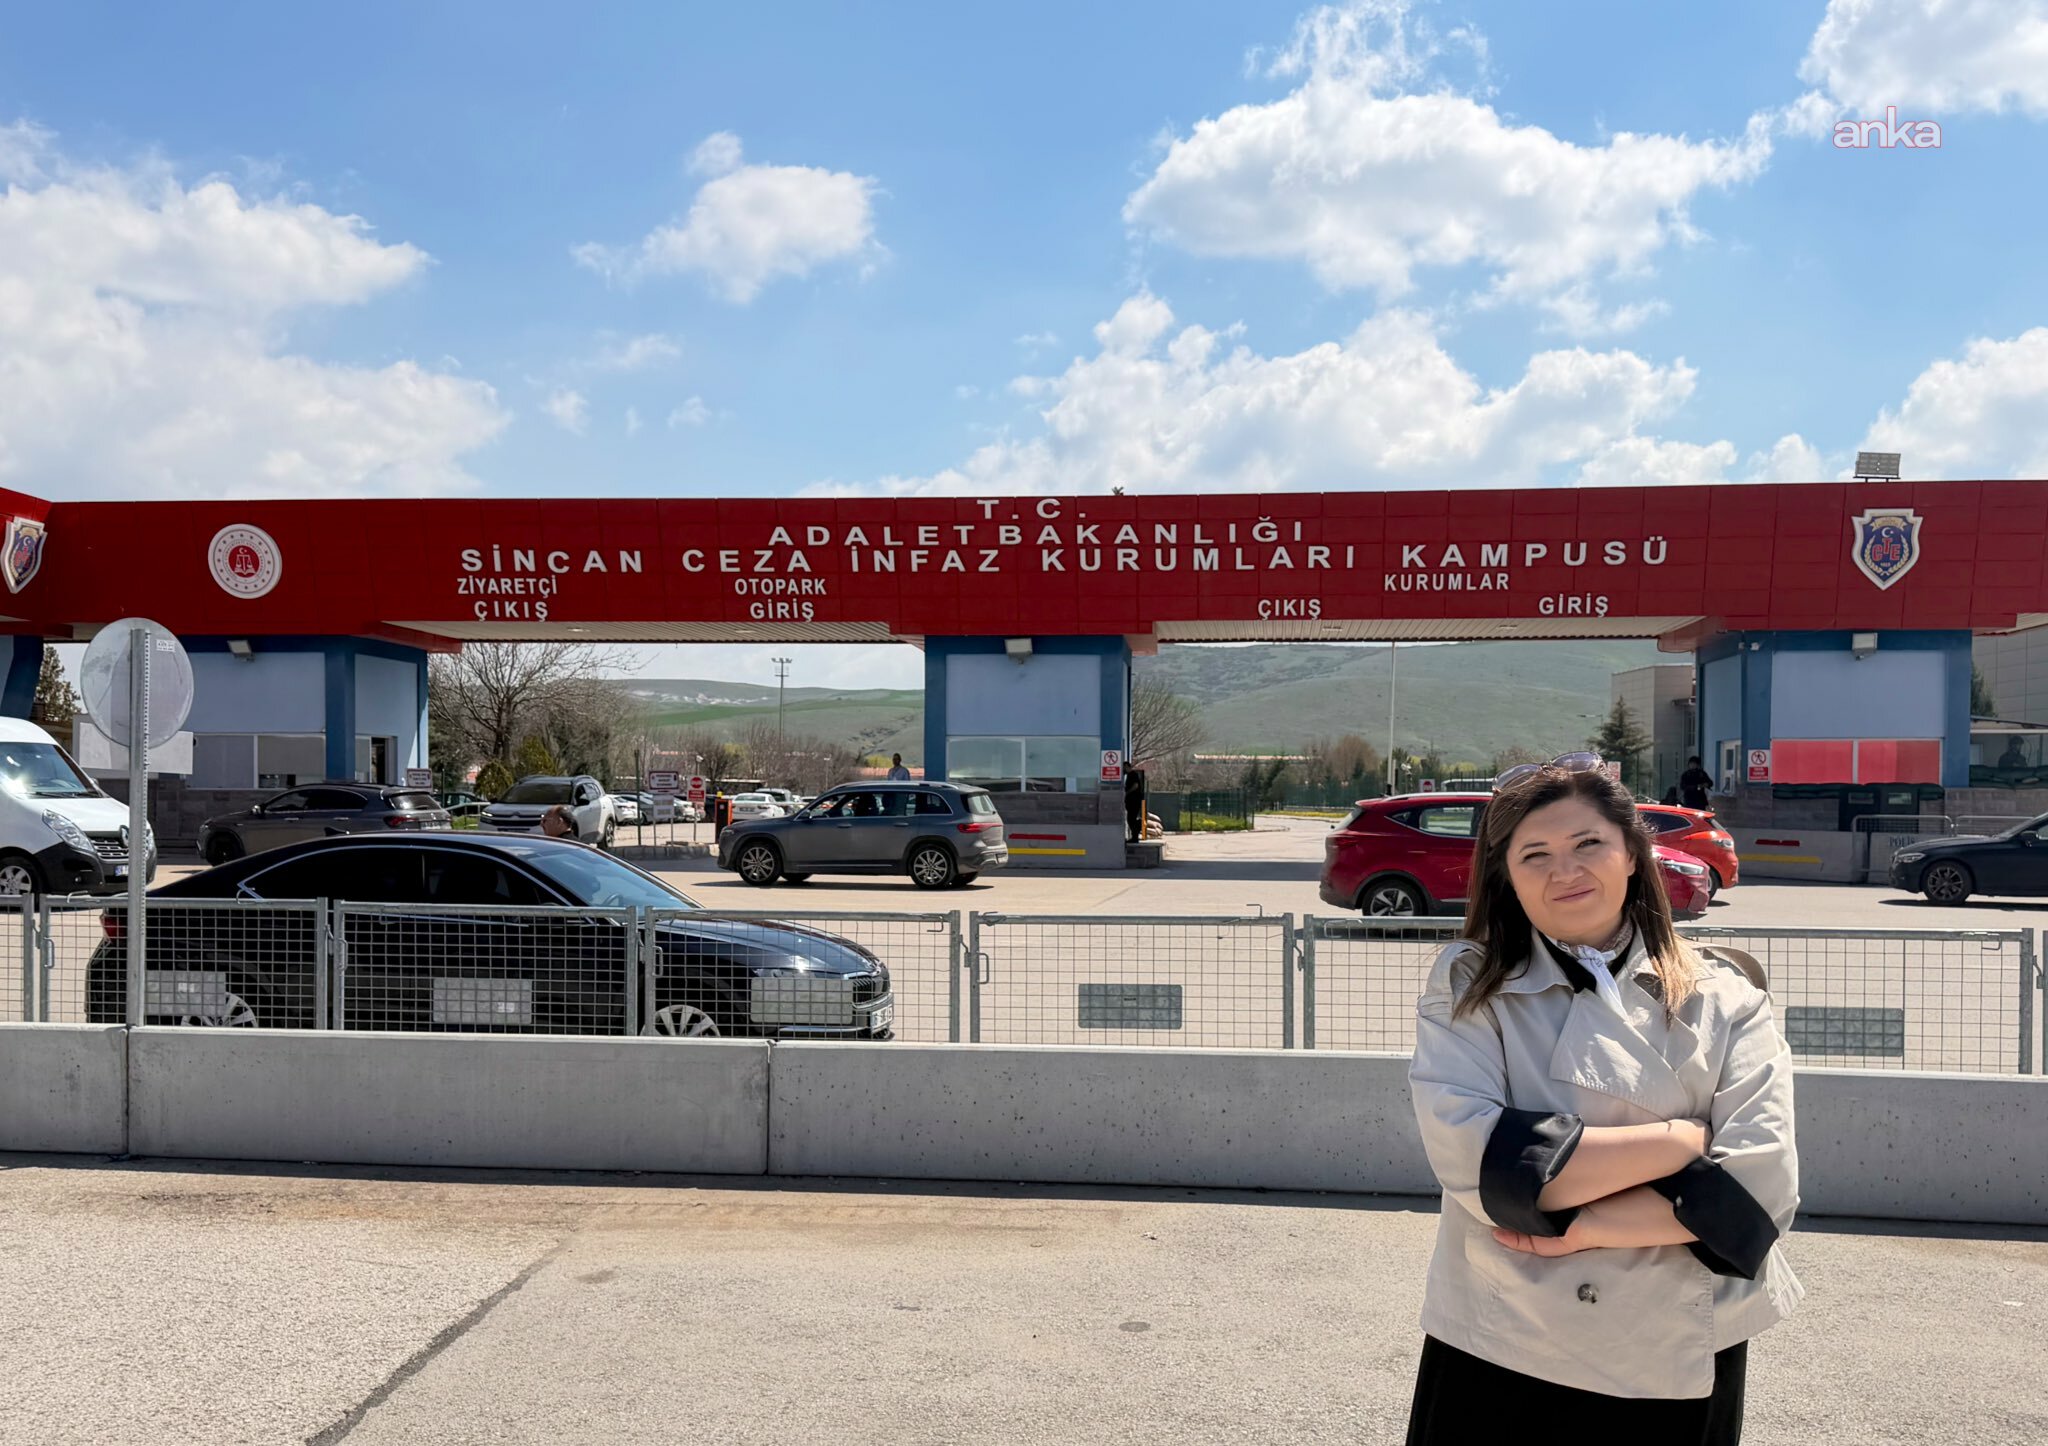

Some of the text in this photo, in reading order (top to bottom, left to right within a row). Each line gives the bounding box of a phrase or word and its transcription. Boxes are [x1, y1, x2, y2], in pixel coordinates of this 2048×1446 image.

[768, 515, 1302, 546] ADALET BAKANLIĞI
[461, 535, 1667, 574] SİNCAN CEZA İNFAZ KURUMLARI KAMPUSÜ
[457, 574, 557, 599] ZİYARETÇİ
[734, 578, 827, 595] OTOPARK
[1384, 572, 1510, 592] KURUMLAR
[474, 600, 549, 622] ÇIKIŞ
[749, 598, 815, 621] GİRİŞ
[1257, 598, 1322, 620] ÇIKIŞ
[1538, 592, 1610, 617] GİRİŞ
